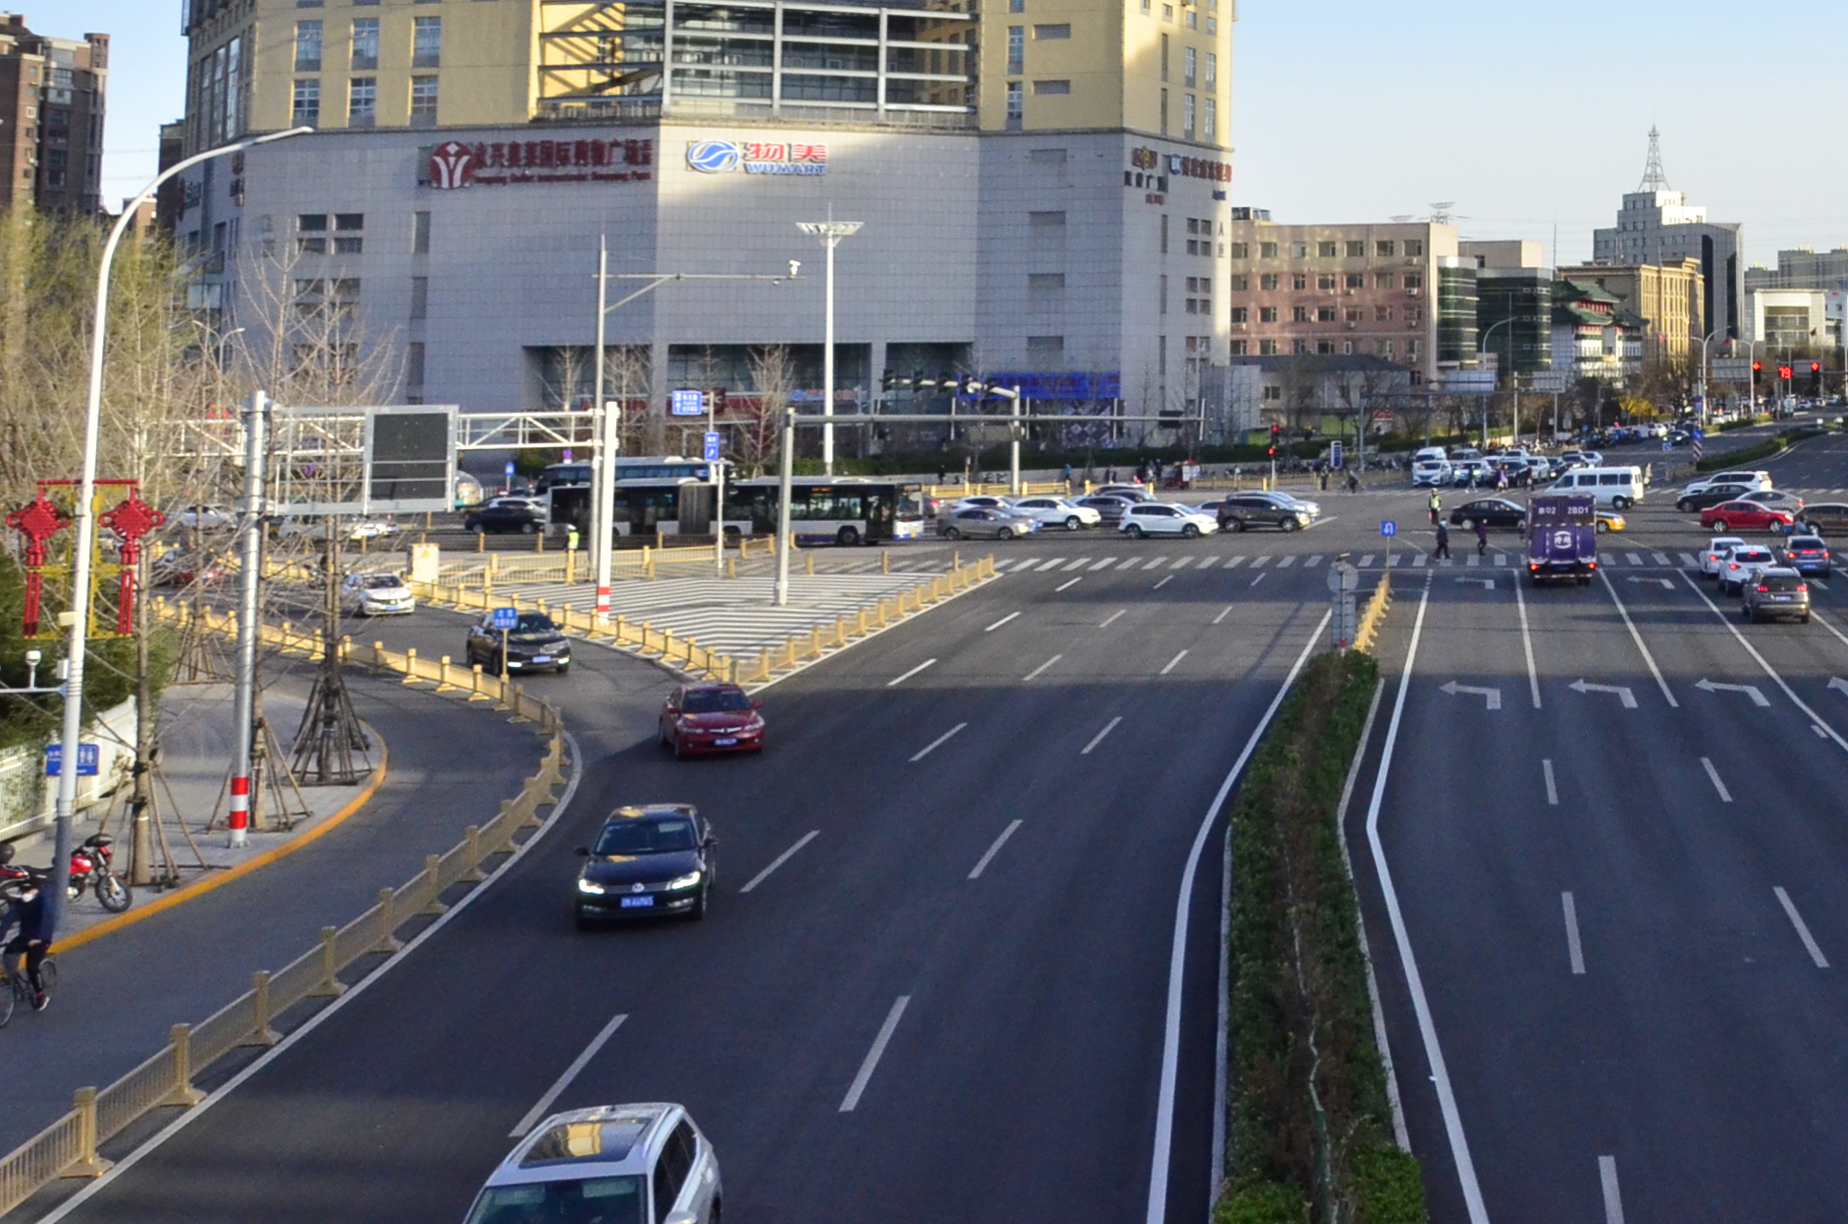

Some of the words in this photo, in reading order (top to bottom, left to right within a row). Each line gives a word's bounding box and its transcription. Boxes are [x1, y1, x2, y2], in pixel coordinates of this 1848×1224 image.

[748, 142, 827, 161] 物美
[748, 163, 826, 175] WUMART
[1778, 366, 1792, 379] 79
